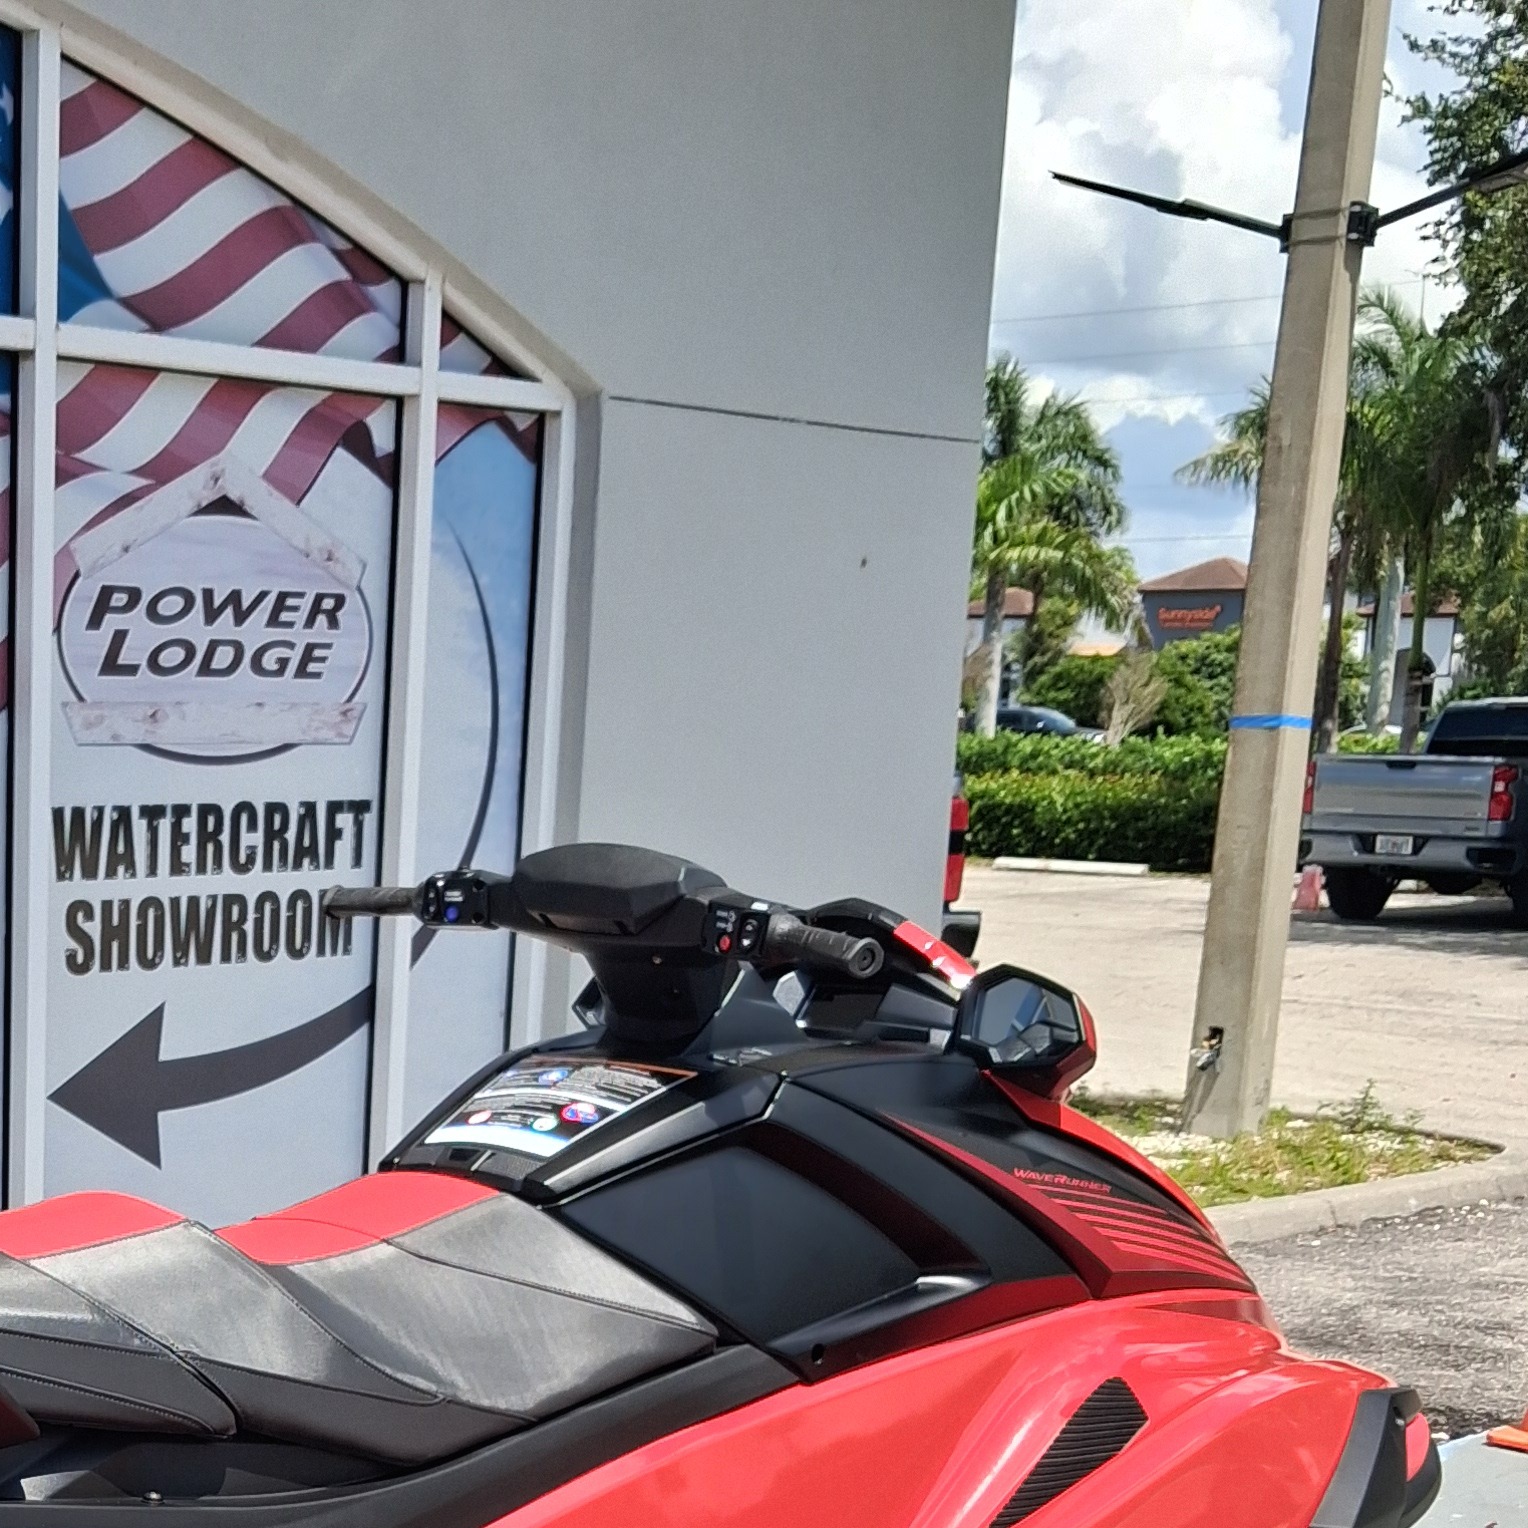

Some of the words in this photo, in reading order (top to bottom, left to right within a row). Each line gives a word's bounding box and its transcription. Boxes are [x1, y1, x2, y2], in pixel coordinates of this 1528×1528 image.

[85, 584, 347, 631] POWER
[97, 629, 334, 680] LODGE
[51, 800, 371, 882] WATERCRAFT
[64, 888, 353, 976] SHOWROOM
